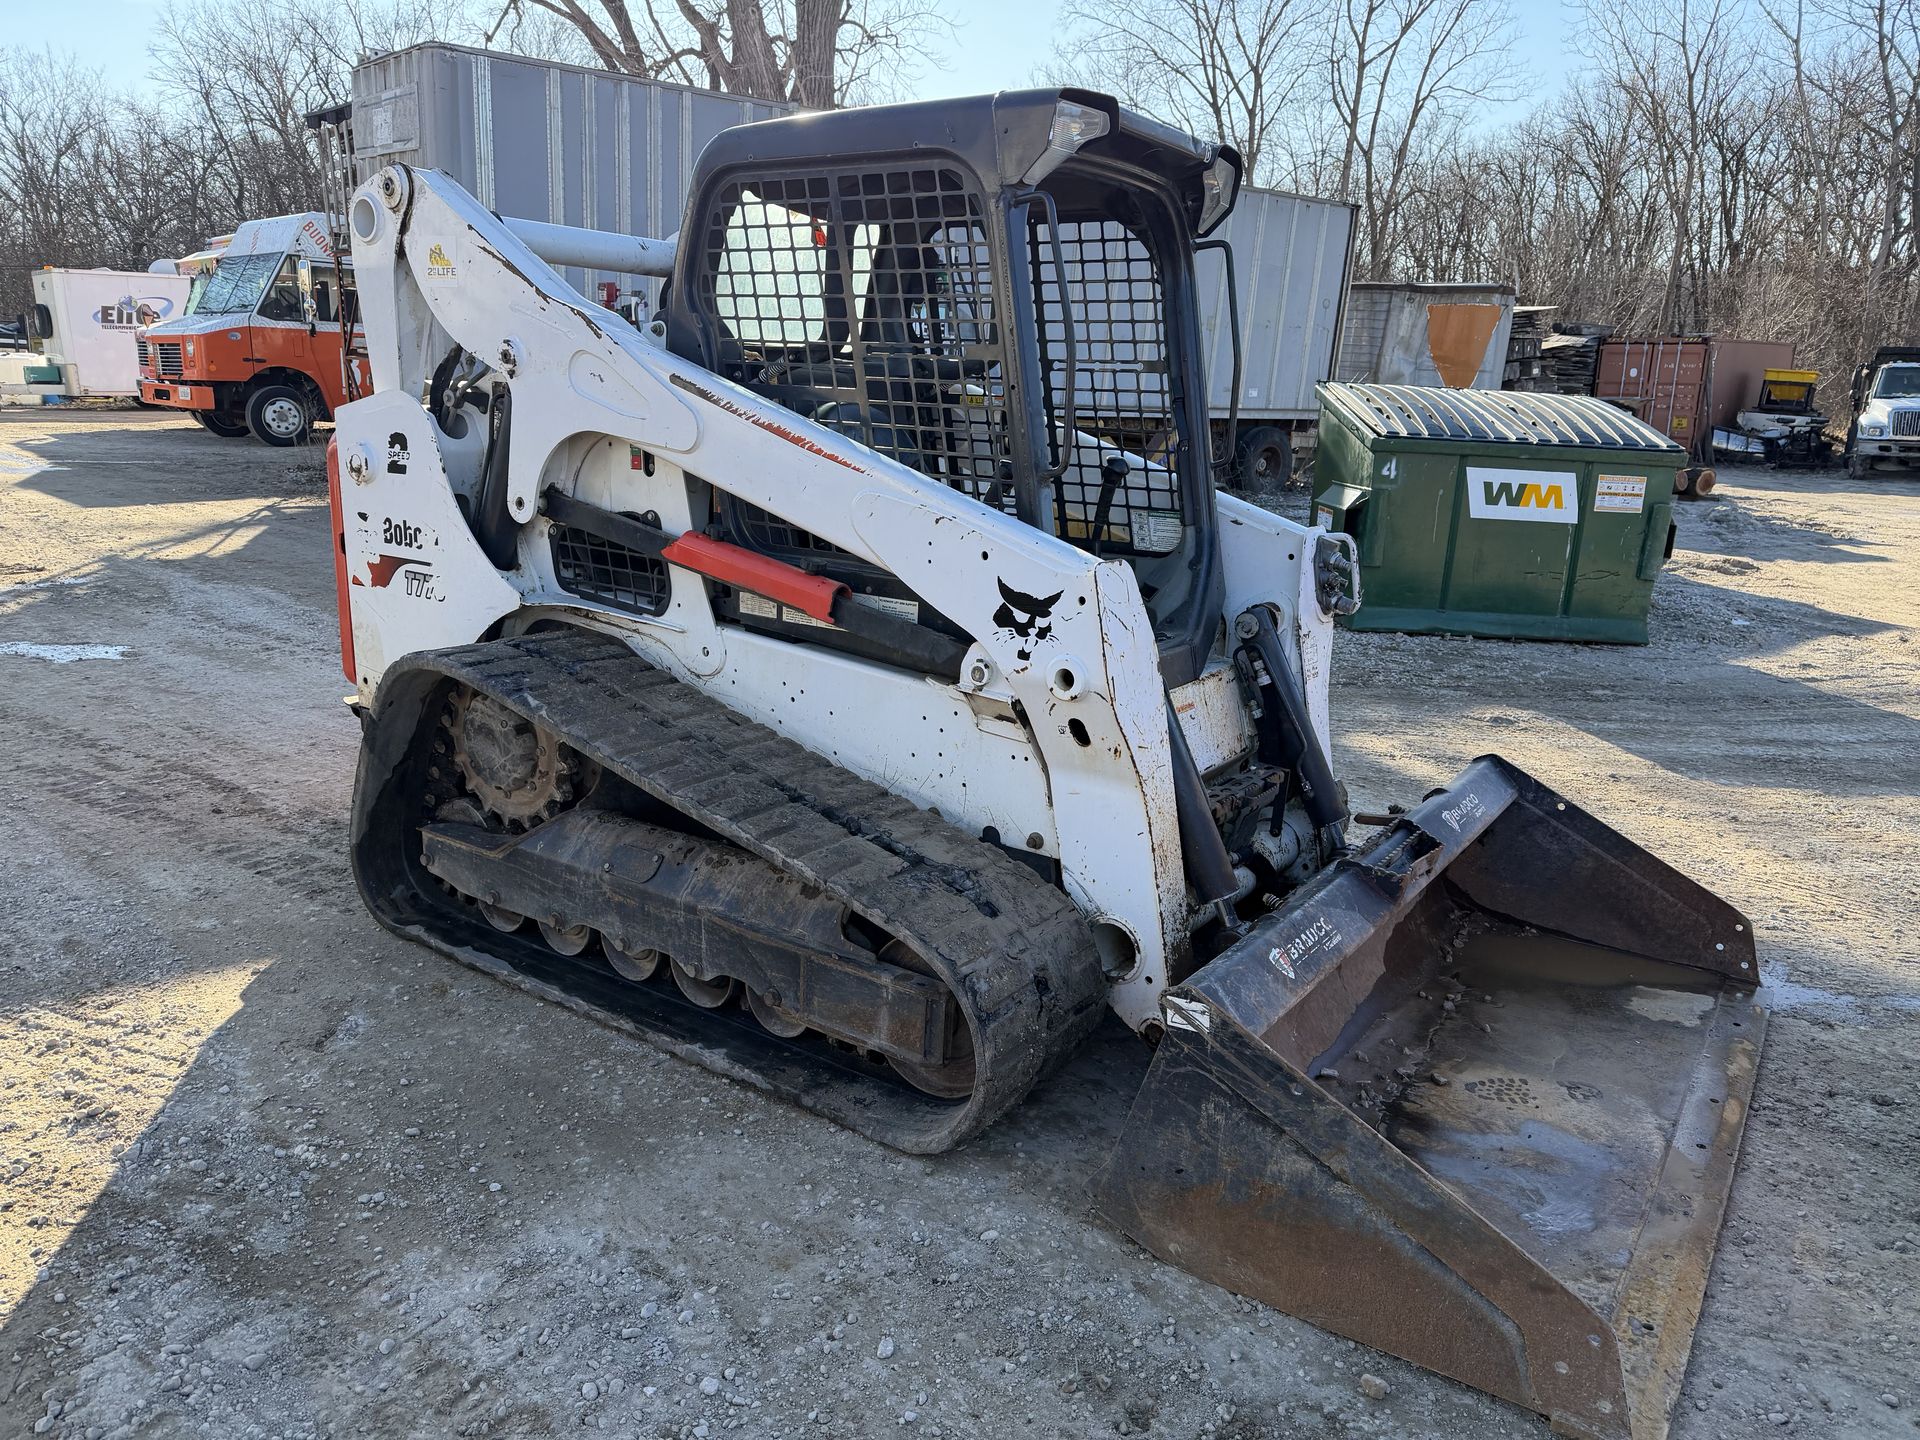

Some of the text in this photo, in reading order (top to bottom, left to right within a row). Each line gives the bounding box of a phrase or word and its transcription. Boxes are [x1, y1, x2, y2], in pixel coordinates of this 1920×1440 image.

[437, 267, 457, 276] LIFE
[387, 450, 411, 461] SPEED
[1380, 457, 1398, 480] 4
[1483, 480, 1565, 509] WM
